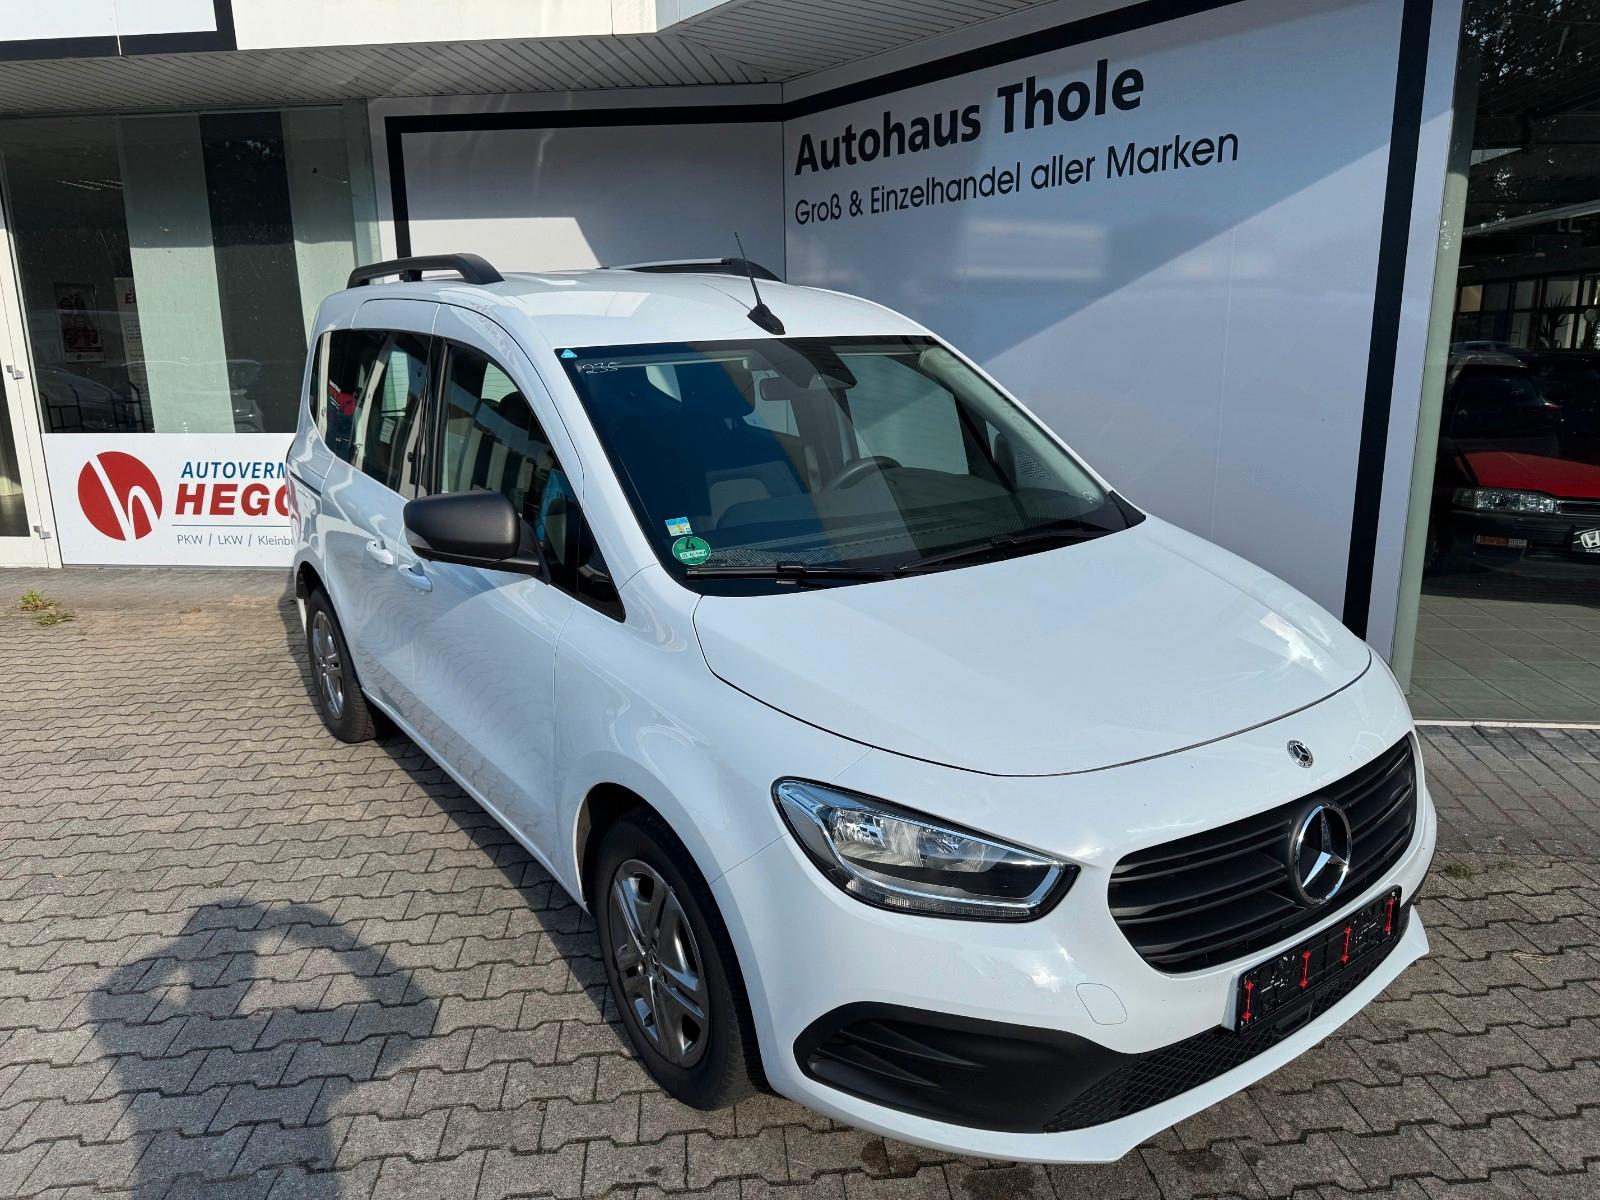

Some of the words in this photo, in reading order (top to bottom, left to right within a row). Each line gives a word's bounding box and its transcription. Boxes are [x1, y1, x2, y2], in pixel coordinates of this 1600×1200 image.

[794, 104, 981, 176] Autohaus
[997, 58, 1145, 134] Thole
[795, 193, 842, 225] Groß
[849, 190, 864, 217] &
[871, 161, 1021, 214] Einzelhandel
[1031, 154, 1096, 190] aller
[1106, 132, 1239, 179] Marken
[177, 534, 203, 544] PKW
[218, 535, 243, 545] LKW
[685, 538, 696, 550] 4
